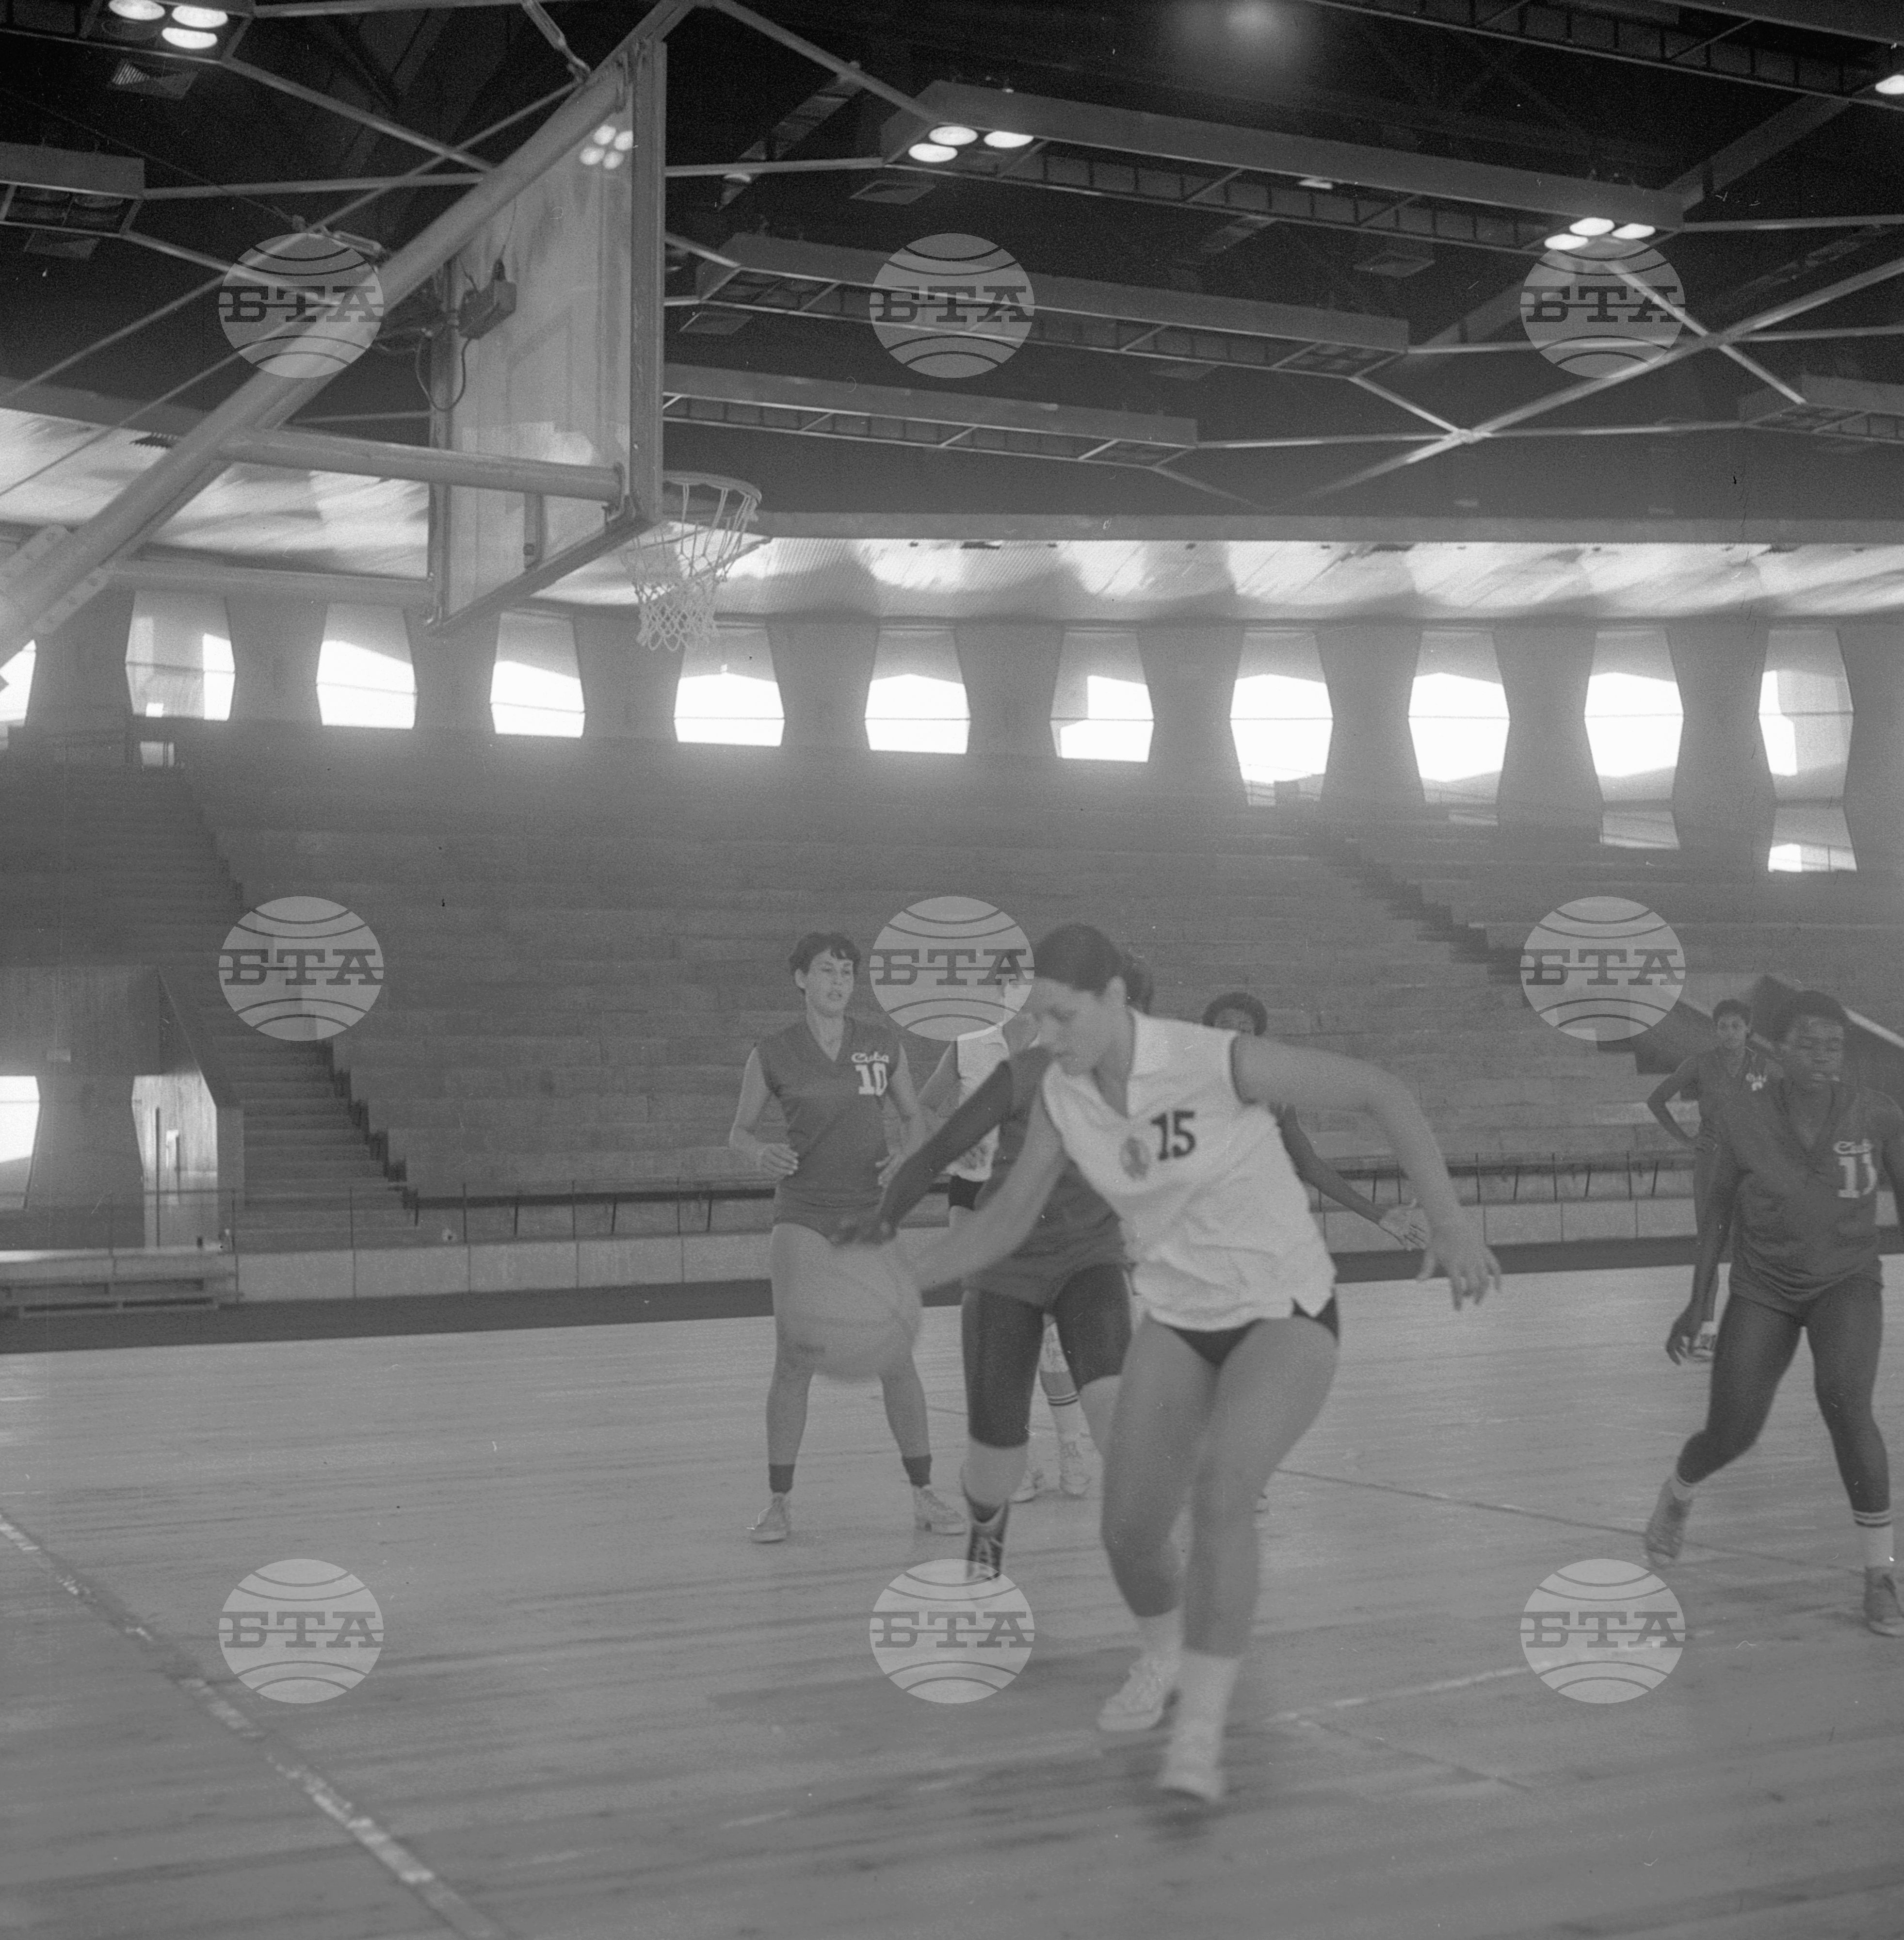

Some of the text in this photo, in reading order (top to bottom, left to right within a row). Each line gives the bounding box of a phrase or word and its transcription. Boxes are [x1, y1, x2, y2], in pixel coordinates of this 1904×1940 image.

[851, 1051, 889, 1064] Cuba
[855, 1062, 888, 1097] 10
[1150, 1110, 1196, 1161] 15
